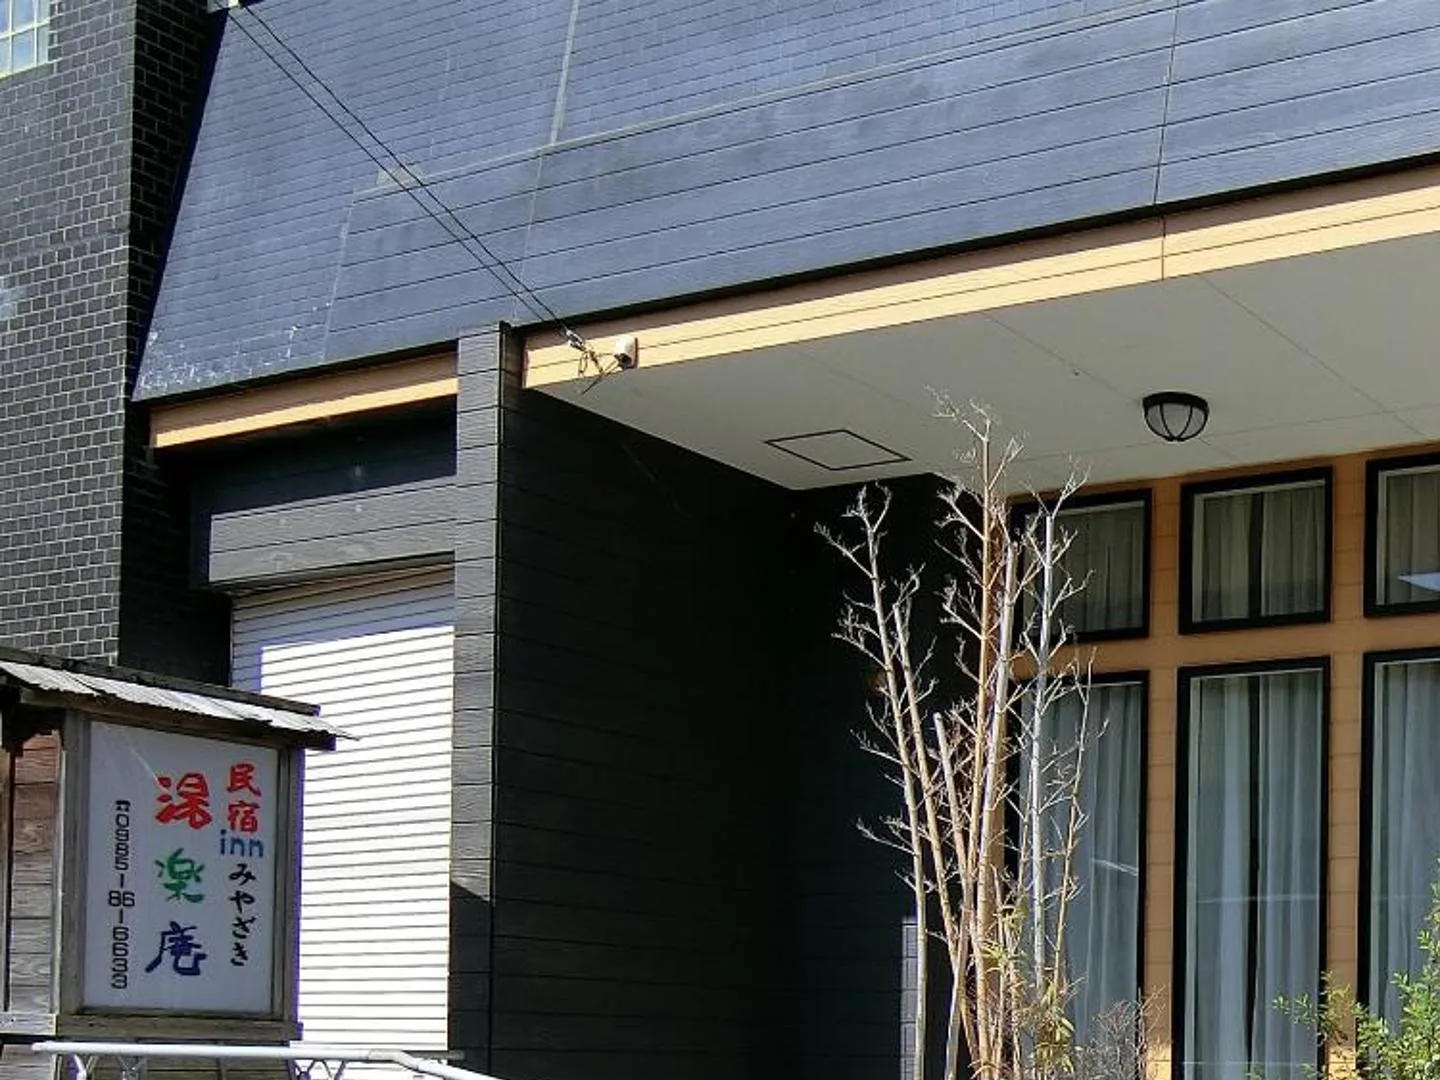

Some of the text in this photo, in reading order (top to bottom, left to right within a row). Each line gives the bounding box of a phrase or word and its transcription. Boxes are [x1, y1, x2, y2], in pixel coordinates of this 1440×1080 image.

[145, 772, 213, 977] 湯楽庵
[219, 763, 264, 967] 民宿 inn みやざき
